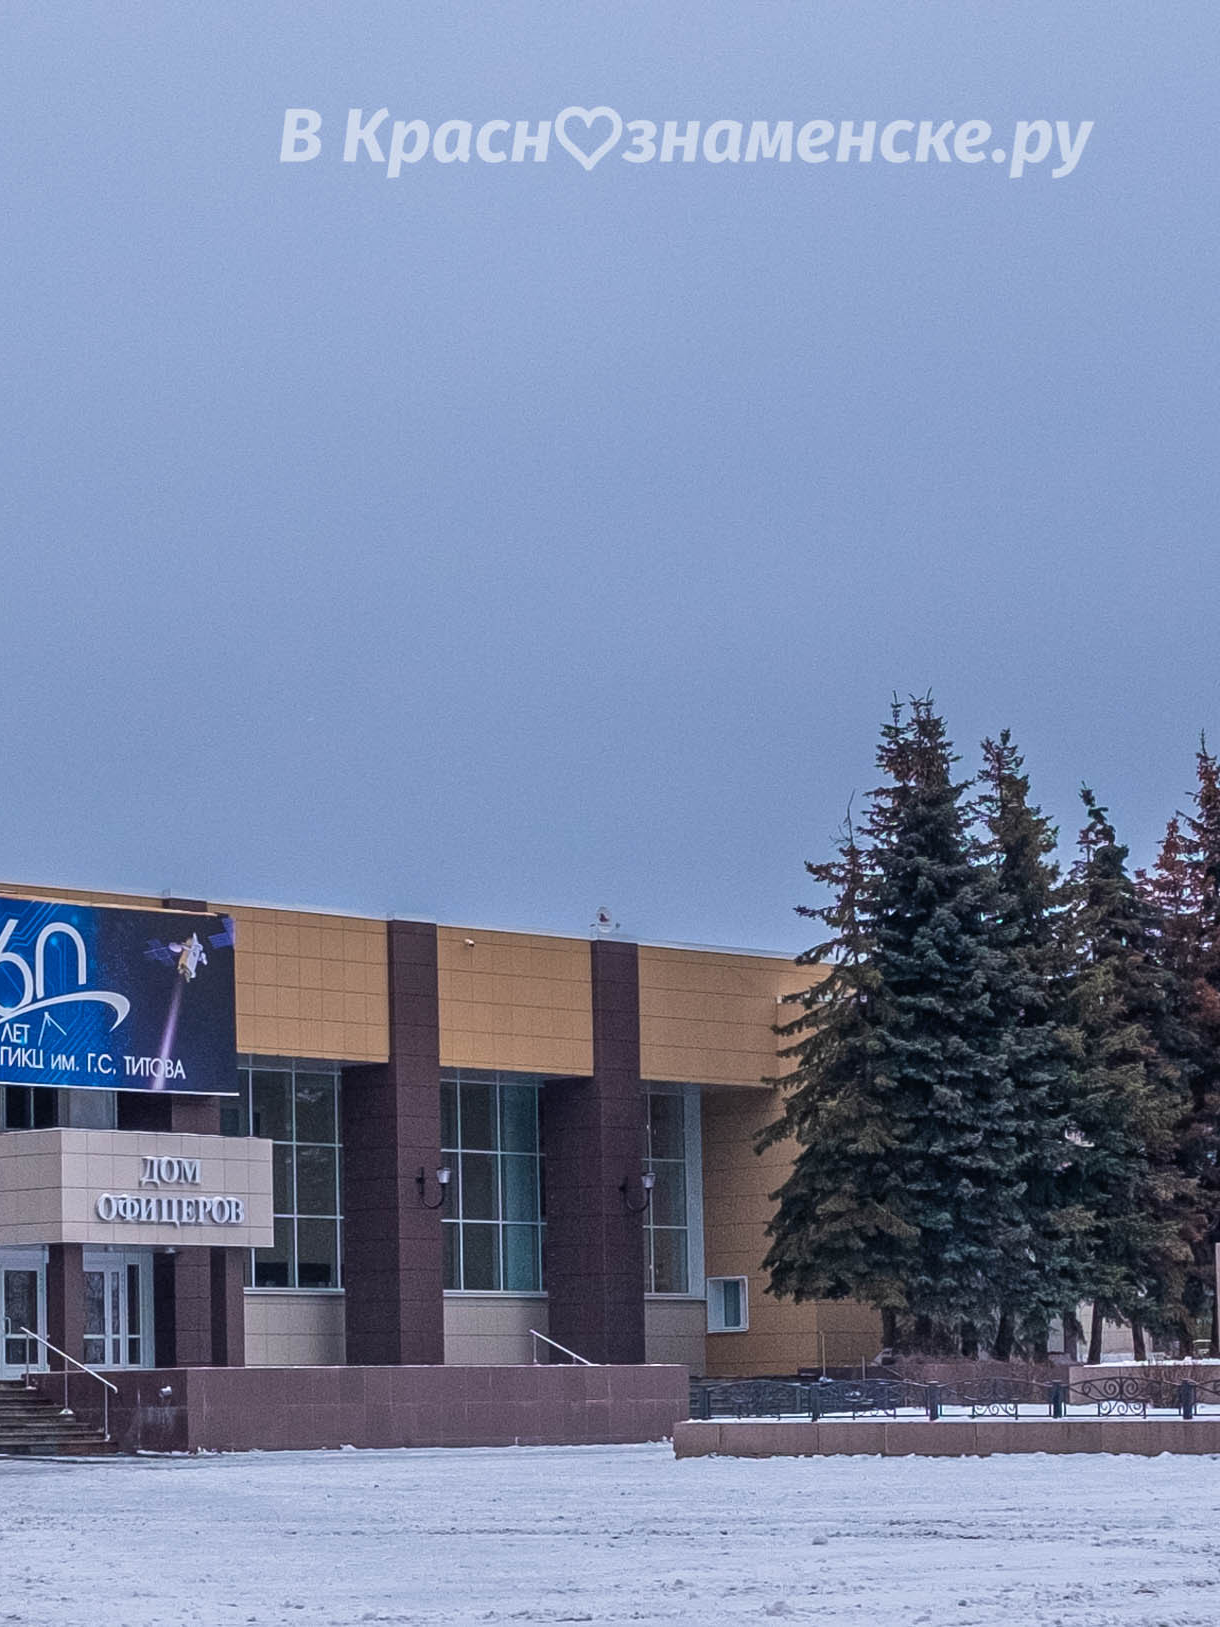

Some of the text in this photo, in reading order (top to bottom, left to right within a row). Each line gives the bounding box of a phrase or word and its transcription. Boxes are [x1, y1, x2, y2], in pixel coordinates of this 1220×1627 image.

[0, 1023, 30, 1044] ЛЕТ
[0, 1046, 186, 1079] ГИКЦ ИМ. Г.С. ТИТОВА
[140, 1156, 201, 1187] ДОМ
[97, 1193, 245, 1227] ОФИЦЕРОВ
